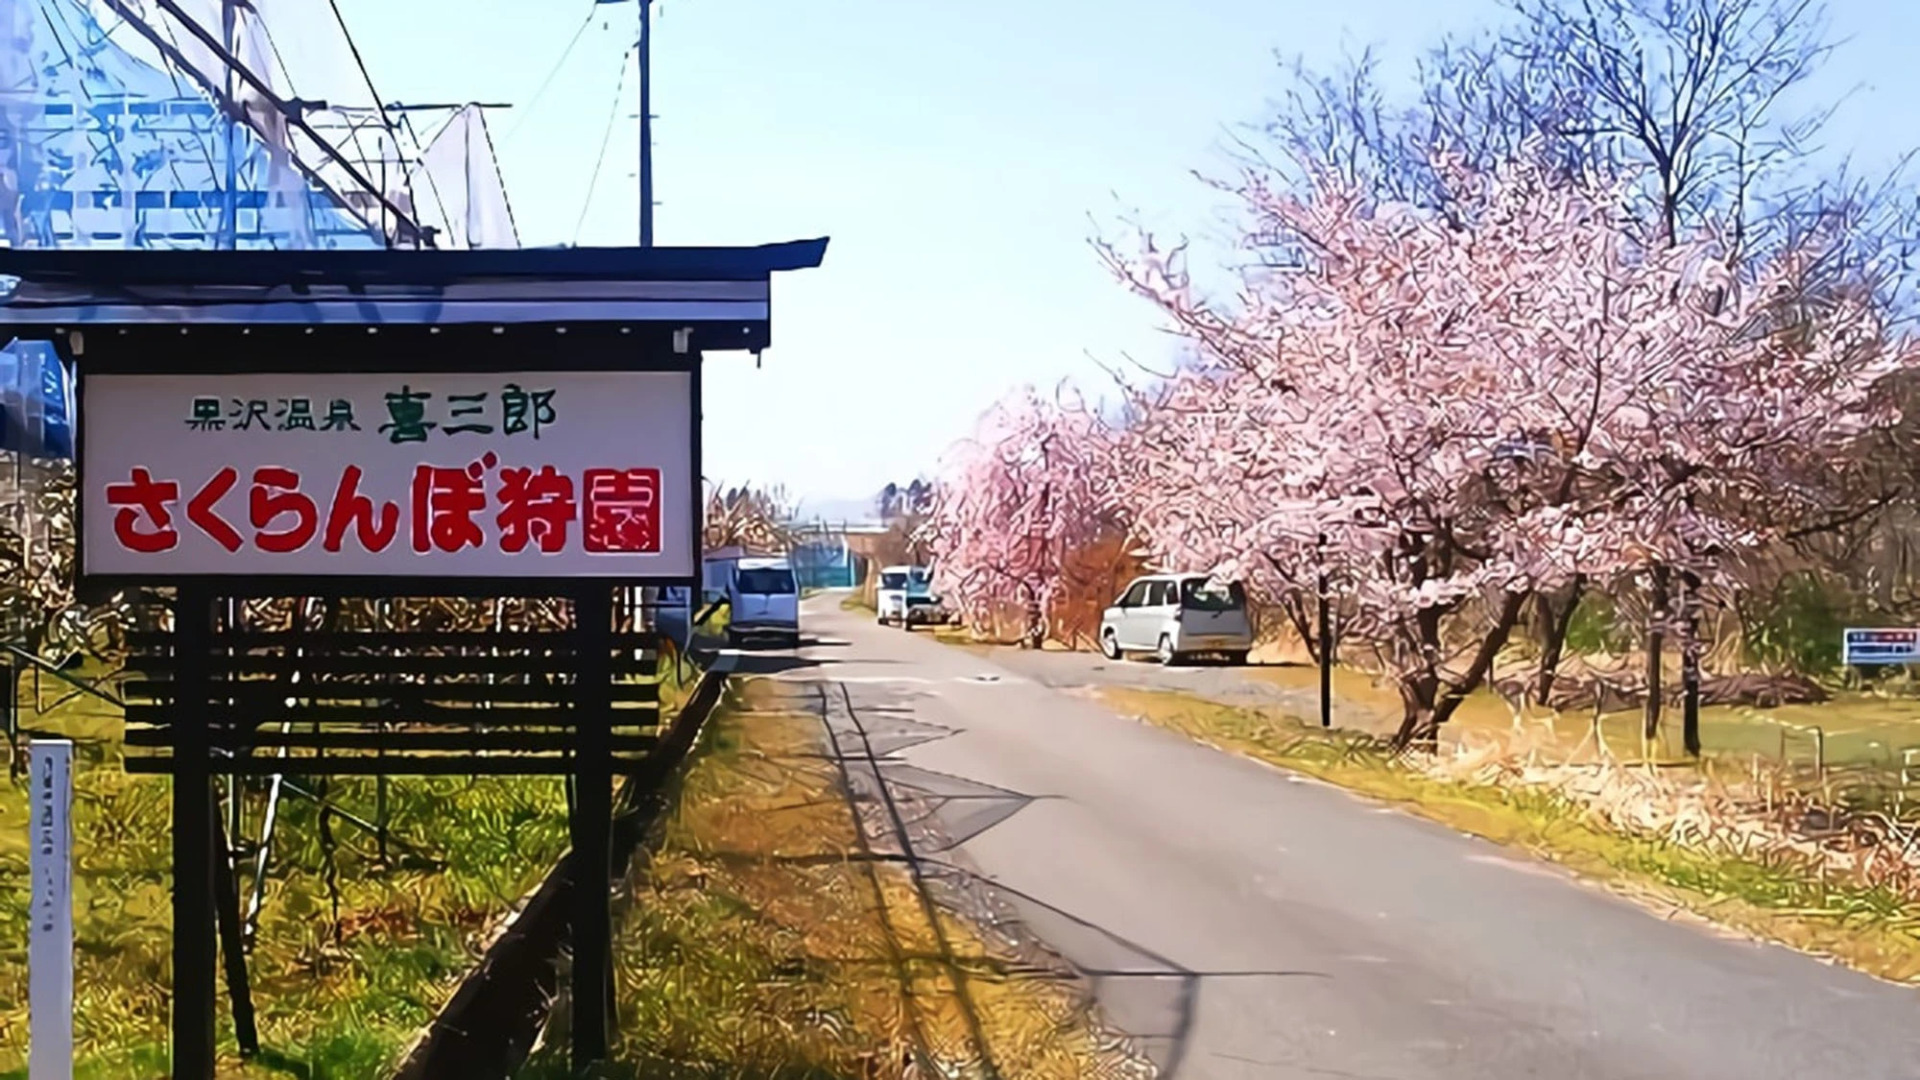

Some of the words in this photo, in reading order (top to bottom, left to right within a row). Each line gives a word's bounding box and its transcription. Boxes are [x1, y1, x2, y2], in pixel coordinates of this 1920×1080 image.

[185, 397, 361, 432] 黒沢温泉
[378, 384, 556, 443] 喜三郎
